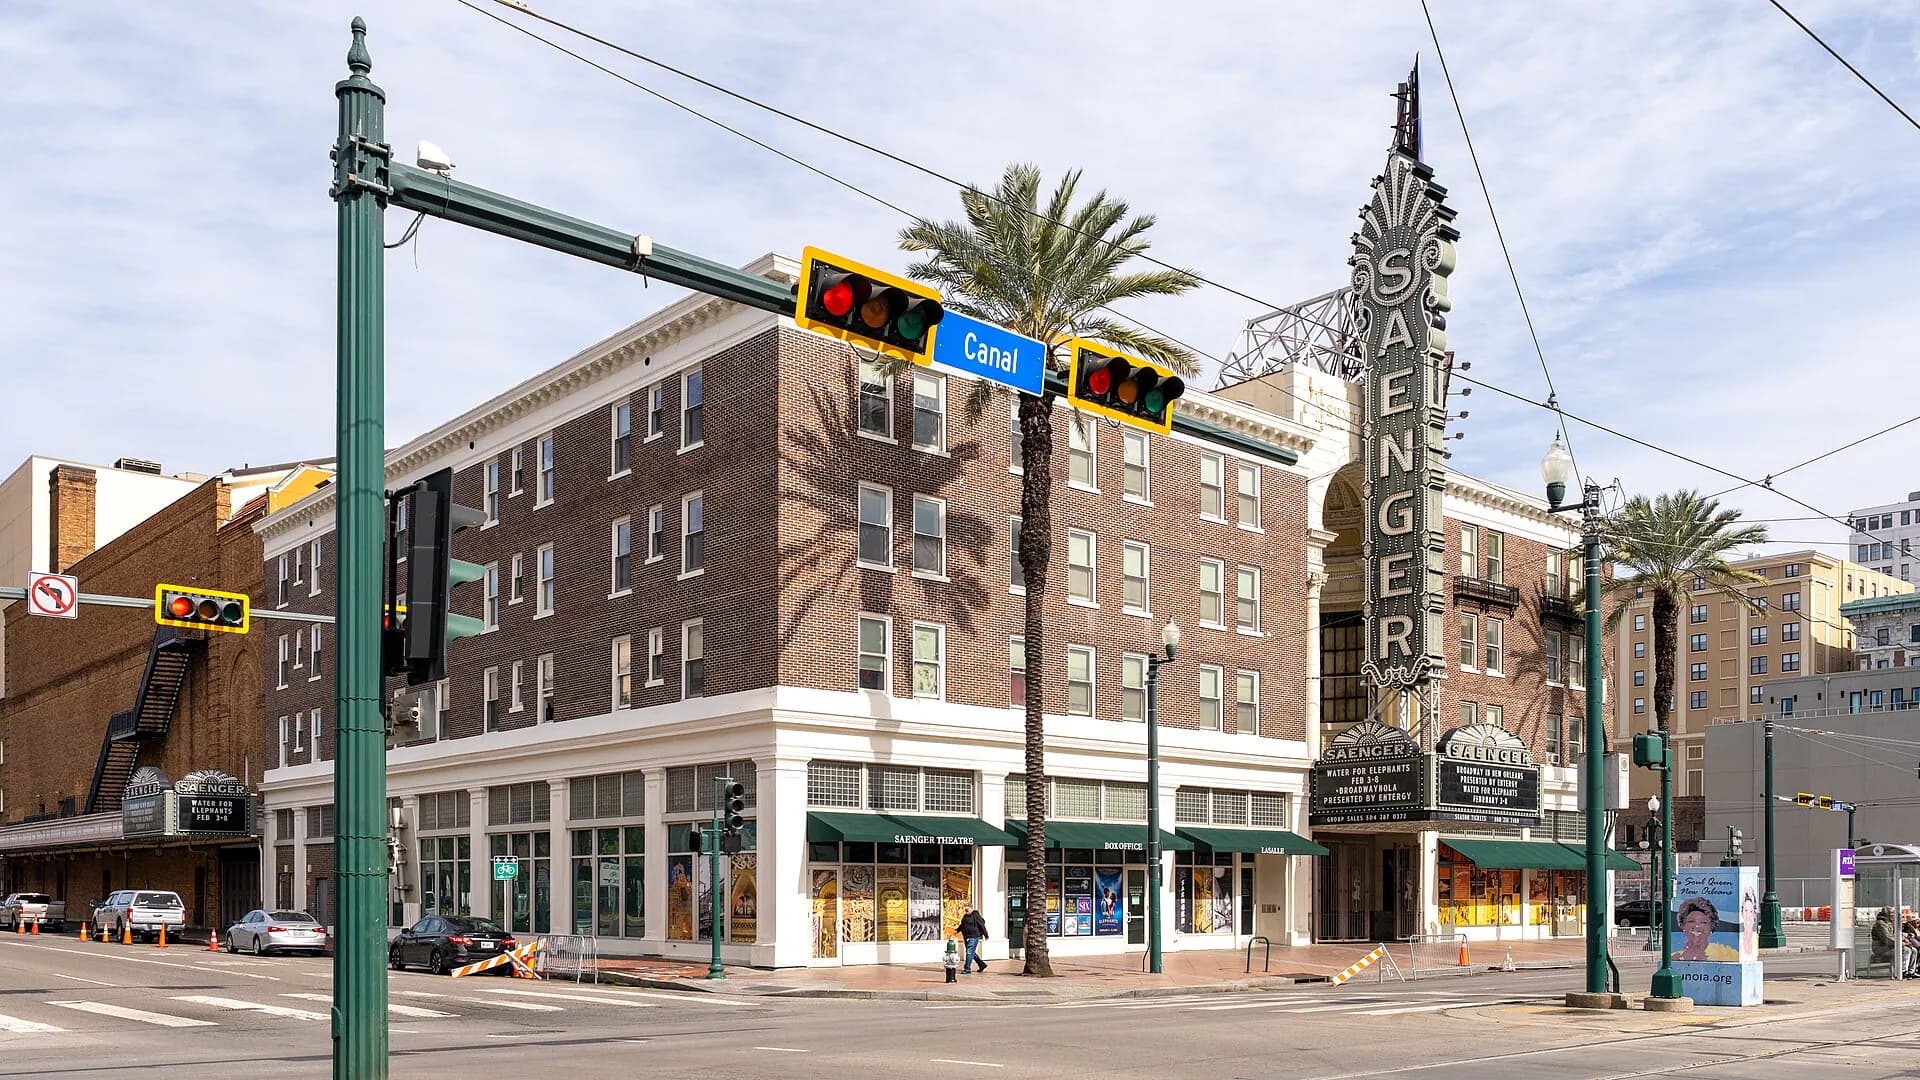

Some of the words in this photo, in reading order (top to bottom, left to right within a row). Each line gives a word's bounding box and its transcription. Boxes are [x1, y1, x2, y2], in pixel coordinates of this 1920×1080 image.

[964, 331, 1018, 374] Canal
[1377, 247, 1416, 660] SAENGER
[1326, 744, 1405, 760] SAENGER
[1451, 744, 1530, 764] SAENGER
[1327, 768, 1350, 777] WATER
[1352, 767, 1366, 775] FOR
[1369, 764, 1411, 775] ELEPHANTS
[1456, 765, 1483, 776] BROADWAY
[1503, 770, 1524, 780] ORLEANS
[1351, 777, 1364, 785] FEB
[1460, 775, 1487, 785] PRESENTED
[1488, 778, 1496, 786] BY
[1497, 779, 1518, 788] ENTERGY
[180, 783, 245, 794] SAENGER
[1463, 785, 1480, 794] WATER
[1481, 786, 1491, 795] FOR
[1492, 787, 1518, 797] ELEPHANTS
[1323, 795, 1363, 805] PRESENTED
[1365, 794, 1376, 802] BY
[1378, 792, 1412, 801] ENTERGY
[1473, 795, 1498, 804] FEBRUARY
[191, 807, 233, 815] ELEPHANTS
[1347, 814, 1364, 822] SALES
[894, 834, 935, 844] SAENGER
[935, 836, 974, 845] THEATRE
[1104, 842, 1118, 850] BOX
[1118, 842, 1143, 850] OFFICE
[1685, 877, 1706, 886] Soul
[1707, 877, 1733, 887] Queen
[1680, 887, 1698, 895] New
[1701, 886, 1733, 895] Orleans
